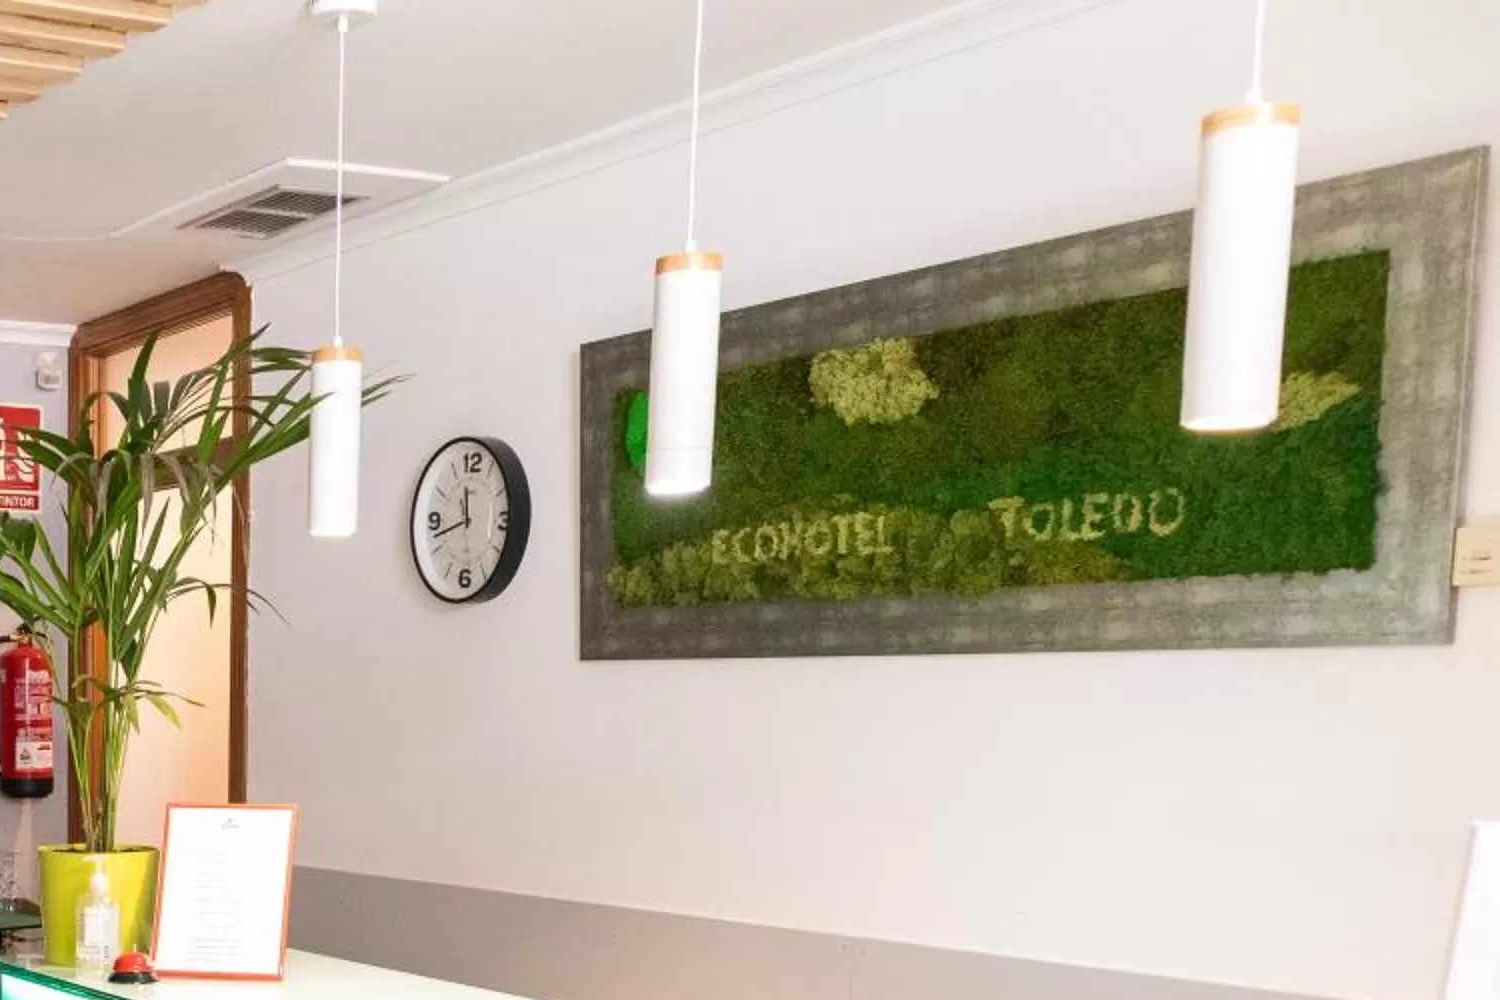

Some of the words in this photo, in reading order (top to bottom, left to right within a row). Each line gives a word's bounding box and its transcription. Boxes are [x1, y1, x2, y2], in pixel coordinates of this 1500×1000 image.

[463, 452, 483, 473] 12
[428, 511, 441, 530] 9
[498, 511, 509, 531] 3
[712, 512, 893, 564] ECOHOTEL
[988, 487, 1184, 541] TOLEDO
[458, 569, 471, 588] 6
